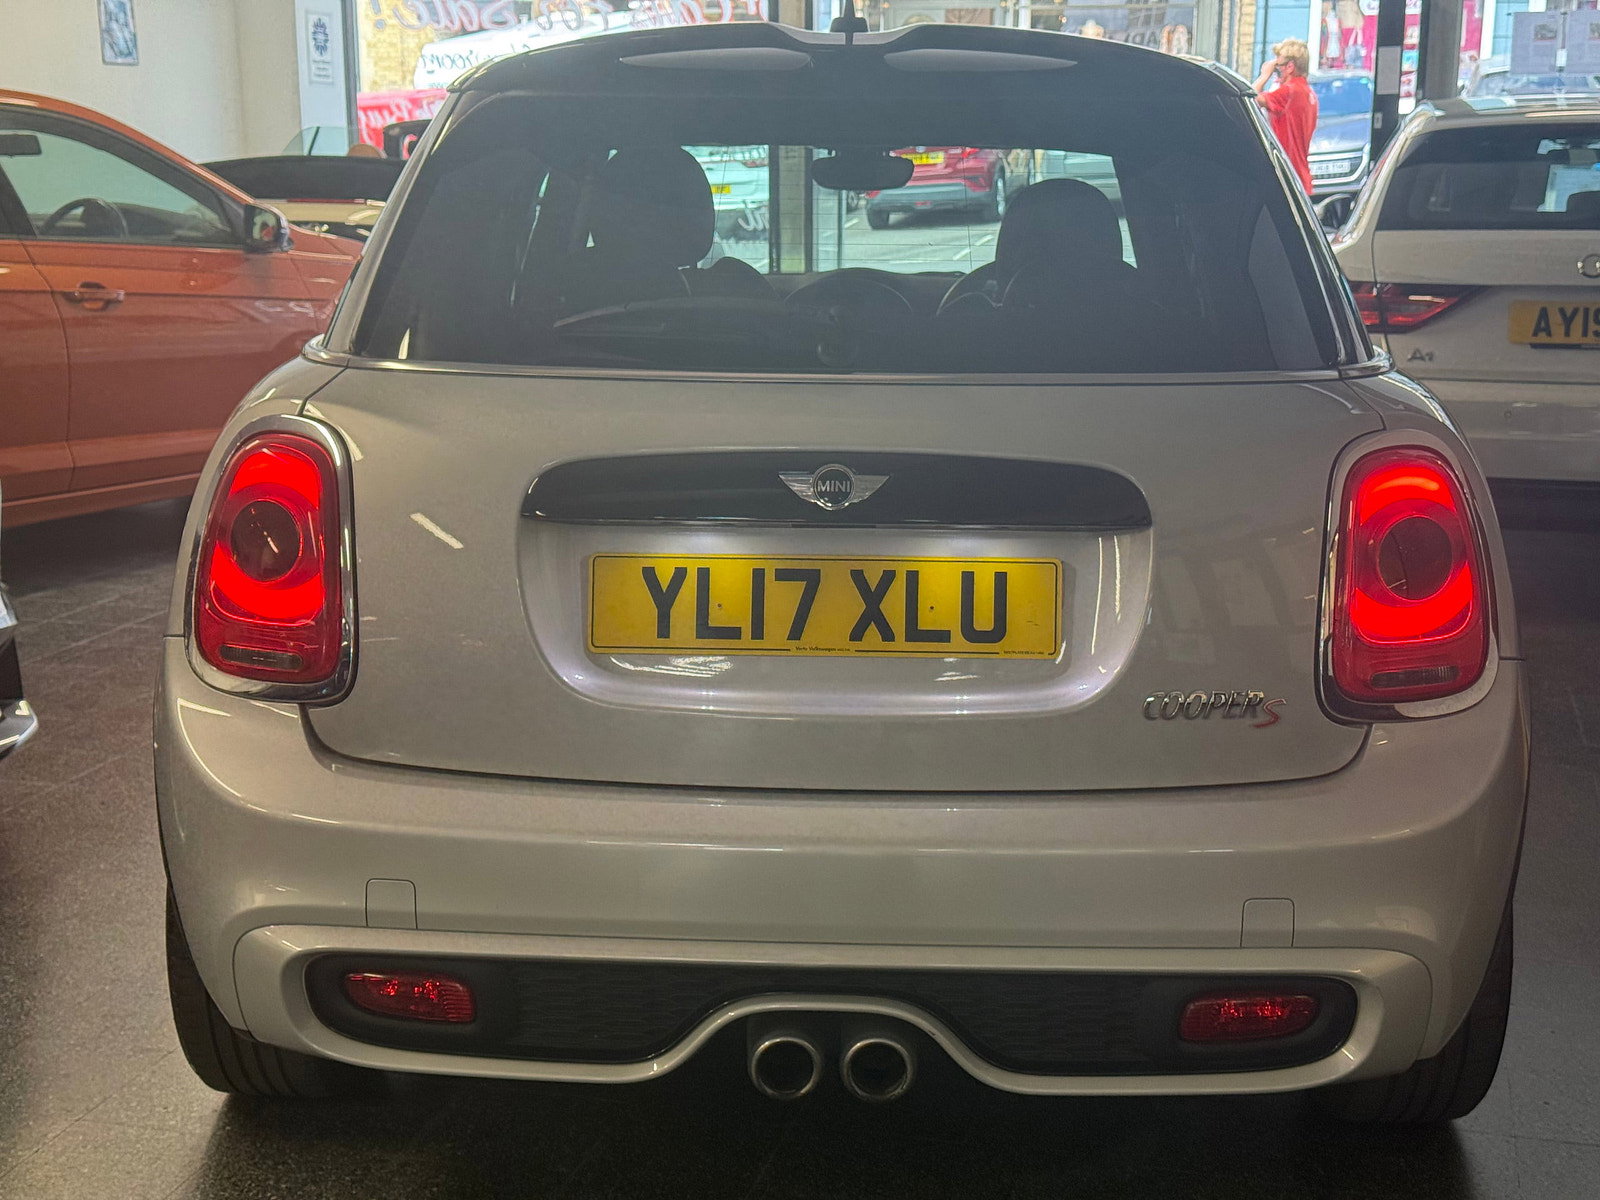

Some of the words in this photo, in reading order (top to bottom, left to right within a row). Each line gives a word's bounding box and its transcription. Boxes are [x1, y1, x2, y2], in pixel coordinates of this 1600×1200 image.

[1407, 348, 1434, 362] A1
[817, 480, 851, 493] MINI
[641, 566, 821, 641] YL17
[848, 569, 1008, 644] XLU
[1142, 690, 1264, 720] COOPER
[1252, 698, 1287, 729] S
